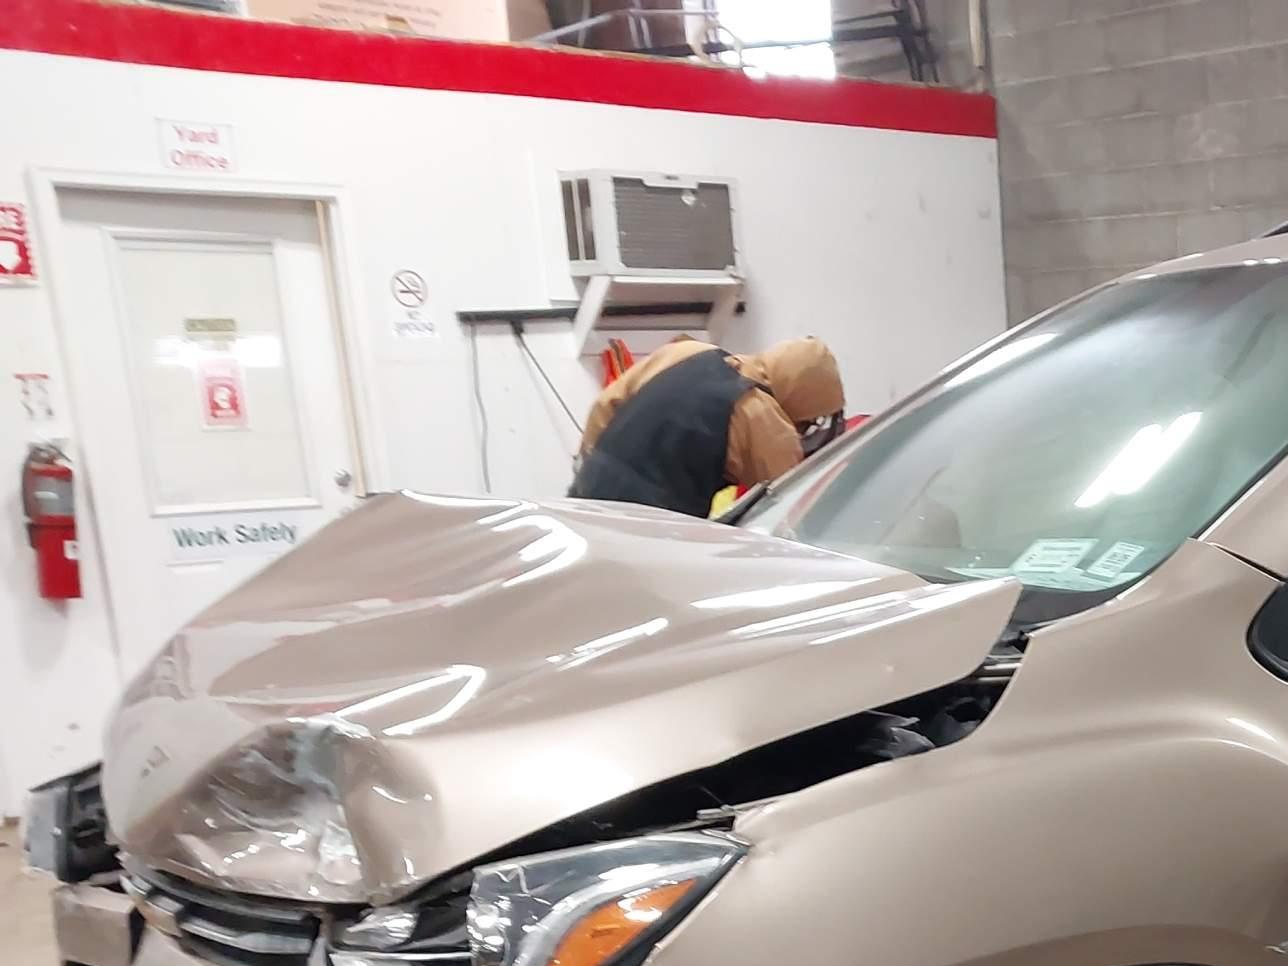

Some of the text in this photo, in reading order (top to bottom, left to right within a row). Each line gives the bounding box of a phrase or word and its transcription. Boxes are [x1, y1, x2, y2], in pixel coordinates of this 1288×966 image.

[172, 125, 219, 144] Yard
[169, 149, 229, 170] Office
[172, 521, 296, 547] Work Safely
